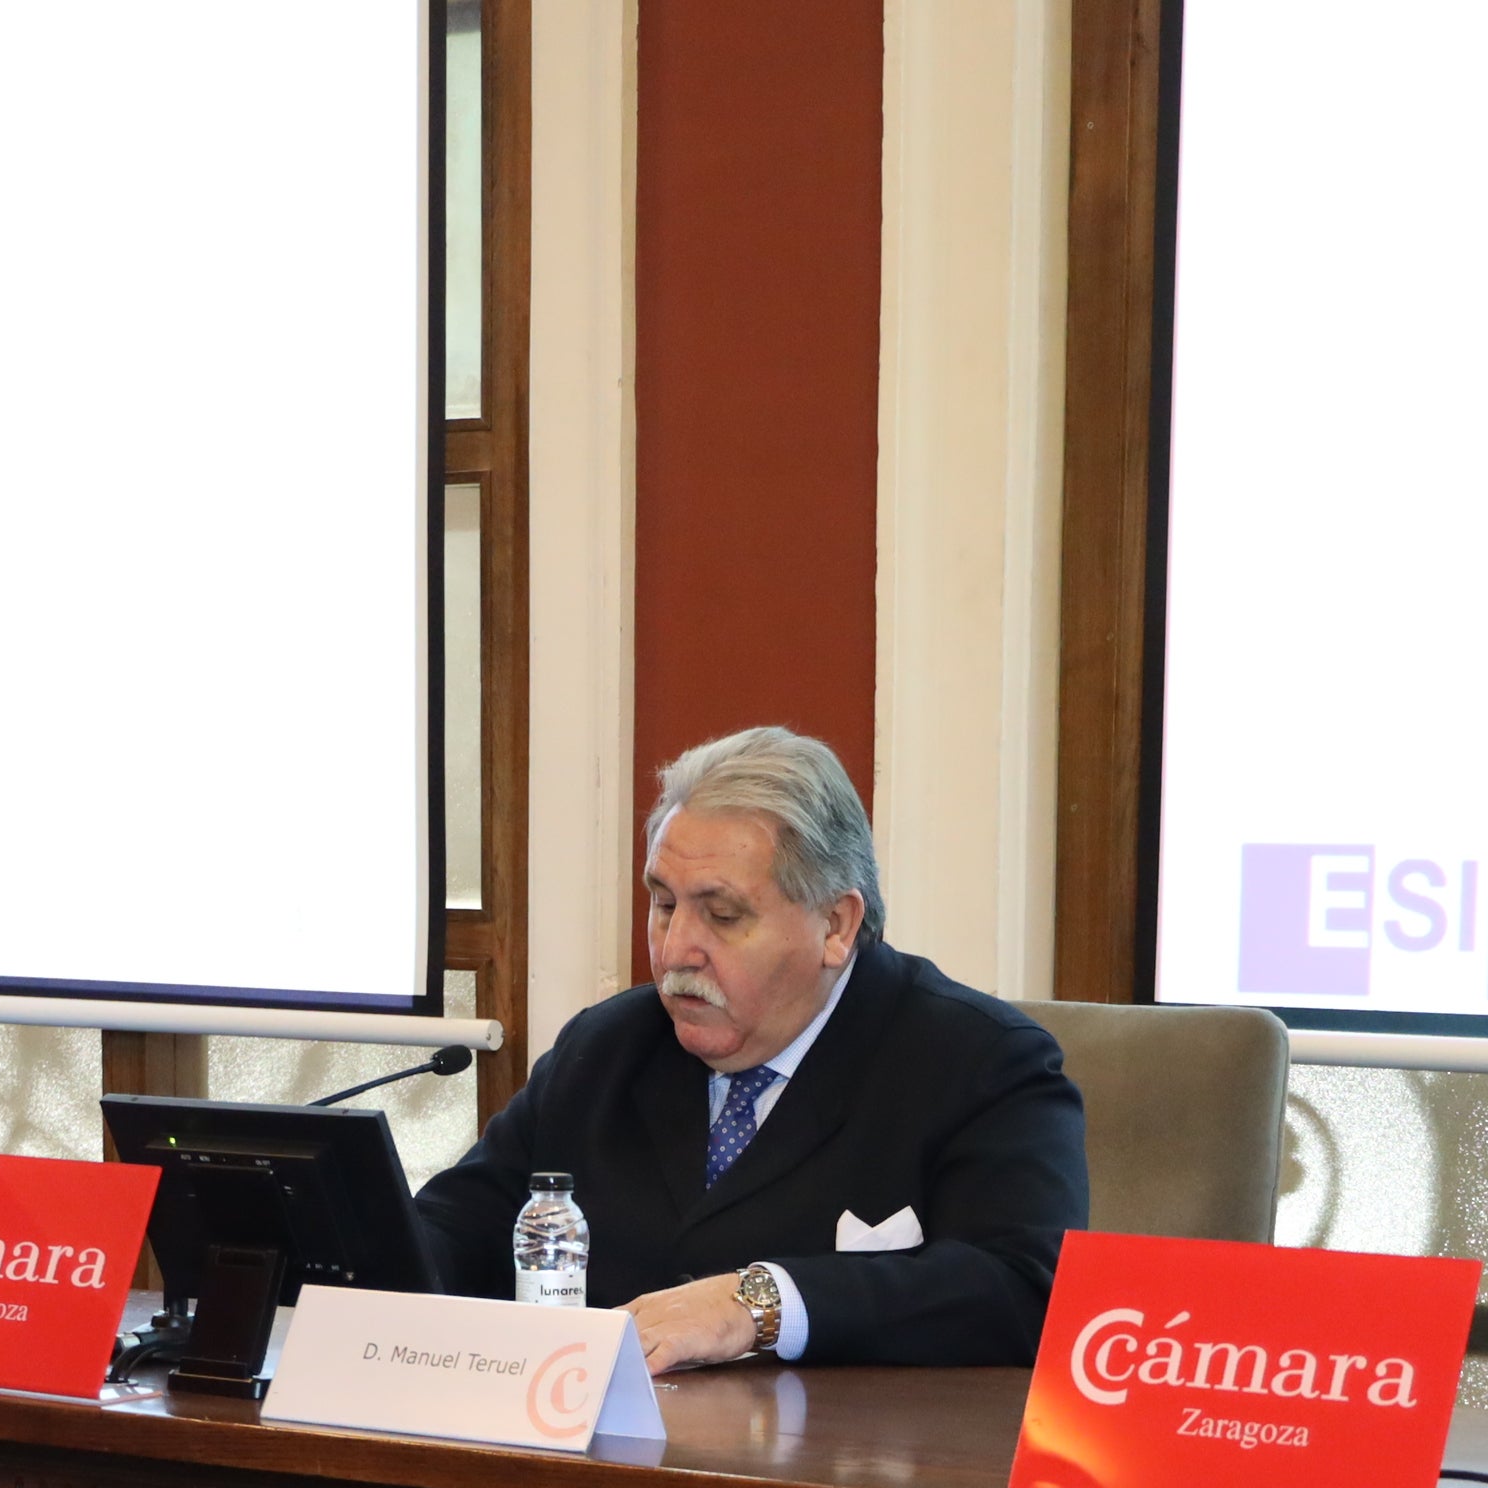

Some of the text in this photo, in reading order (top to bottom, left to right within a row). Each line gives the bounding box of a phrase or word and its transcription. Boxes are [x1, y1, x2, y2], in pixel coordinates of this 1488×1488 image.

[1308, 854, 1479, 953] ESI
[362, 1341, 528, 1376] D. Manuel Teruel
[1176, 1407, 1310, 1449] Zaragoza
